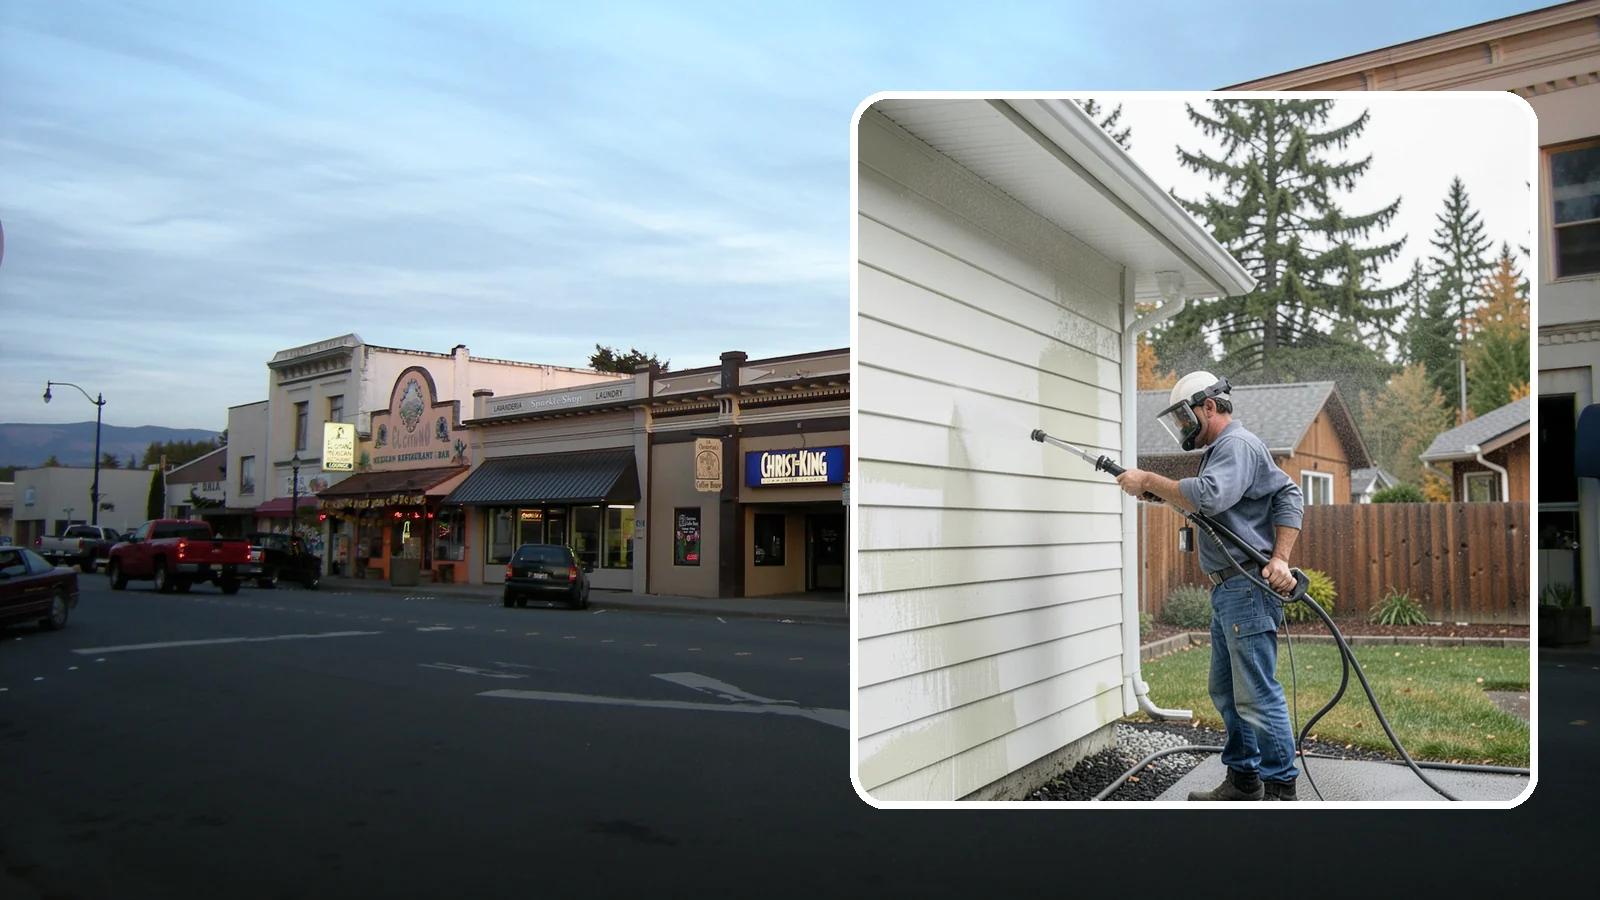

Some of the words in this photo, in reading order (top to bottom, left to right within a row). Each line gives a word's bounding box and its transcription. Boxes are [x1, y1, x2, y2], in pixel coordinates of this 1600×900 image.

[493, 402, 522, 412] LAVANDERIA
[531, 399, 560, 409] Sparkle
[562, 394, 582, 404] Shop
[595, 389, 623, 400] LAUNDRY
[374, 455, 396, 464] MEXICAN
[398, 452, 433, 462] RESTAURANT
[438, 450, 450, 459] BAR
[761, 452, 797, 478] CHRIST
[799, 450, 827, 476] KING
